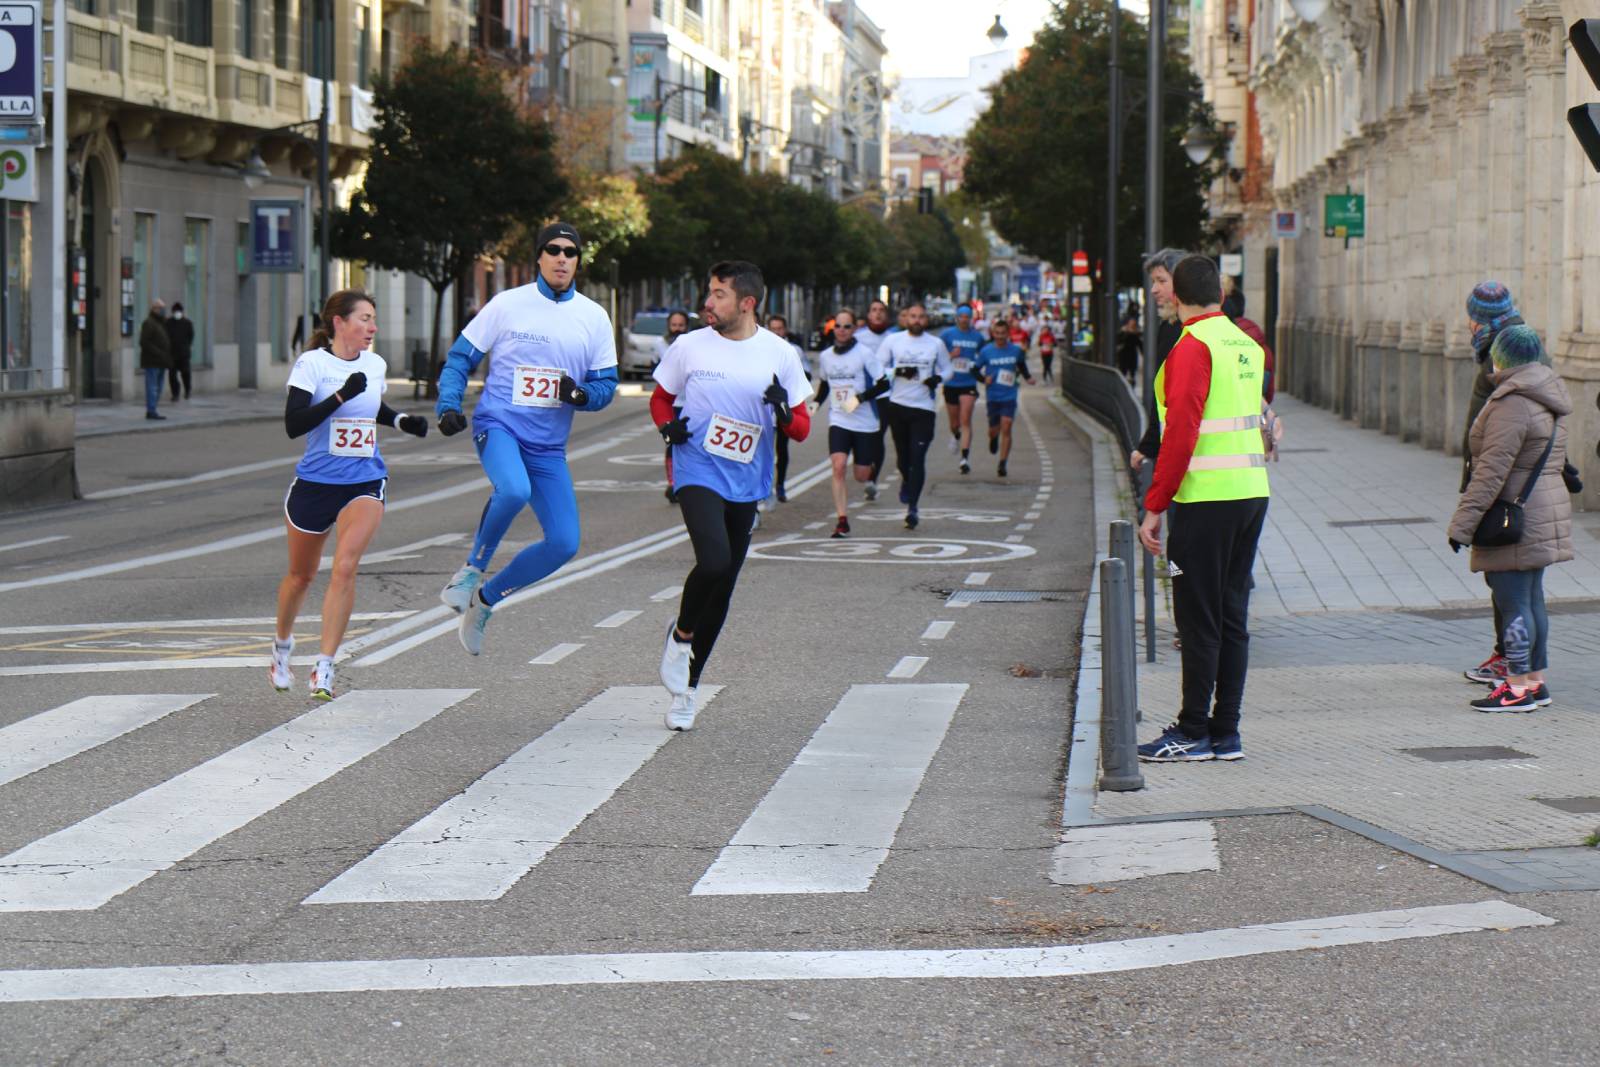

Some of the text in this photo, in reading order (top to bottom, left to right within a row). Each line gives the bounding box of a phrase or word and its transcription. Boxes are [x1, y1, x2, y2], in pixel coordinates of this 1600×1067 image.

[257, 207, 291, 249] T
[521, 376, 560, 399] 321
[335, 428, 375, 448] 324
[710, 425, 753, 454] 320
[800, 542, 968, 558] 30
